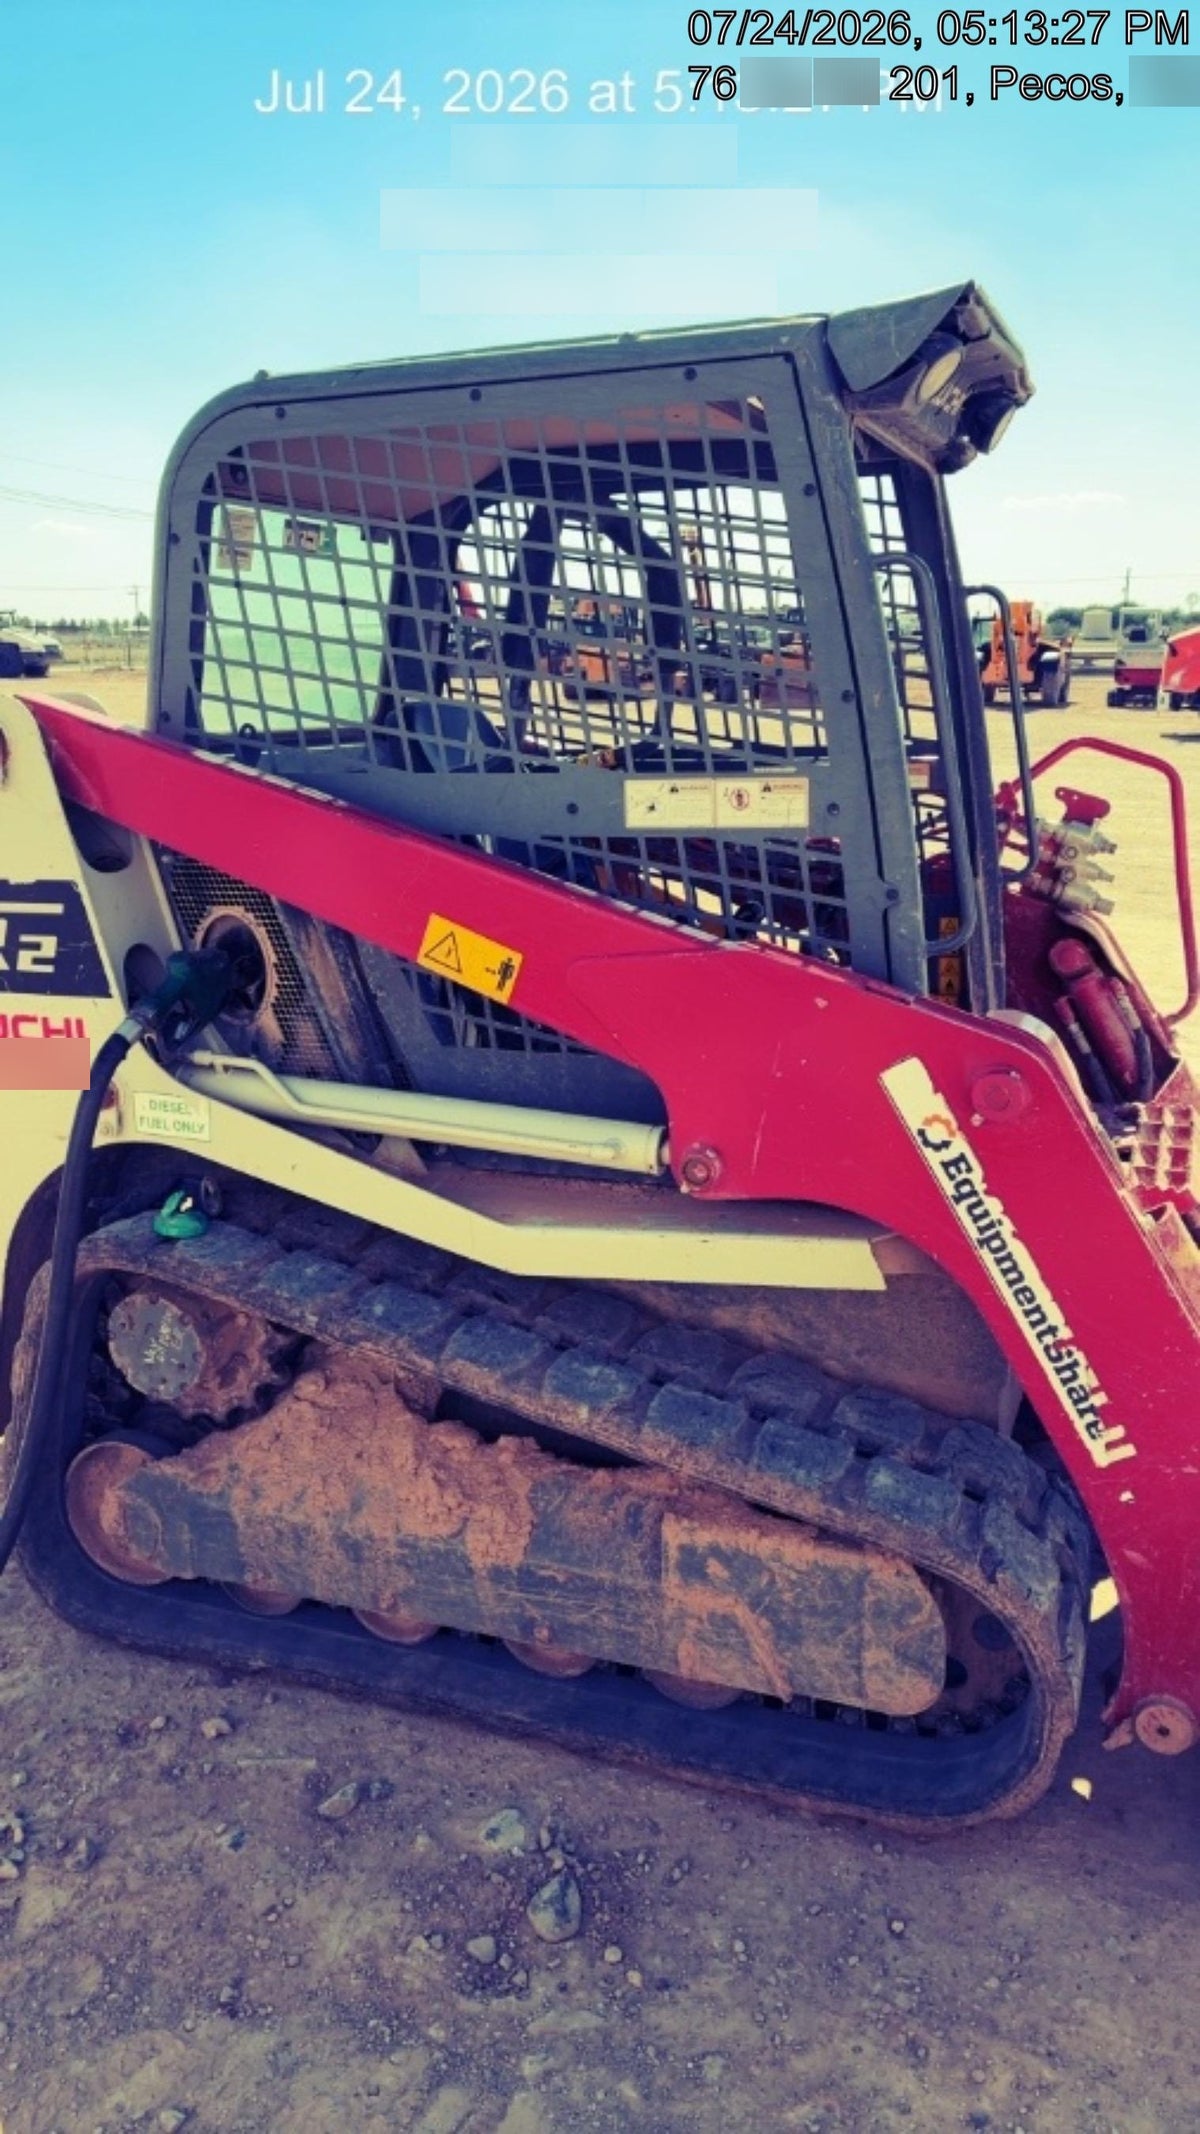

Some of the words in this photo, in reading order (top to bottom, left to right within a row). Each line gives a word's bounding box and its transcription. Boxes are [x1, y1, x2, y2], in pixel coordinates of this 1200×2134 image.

[149, 1099, 192, 1115] DIESEL
[139, 1116, 170, 1131] FUEL
[173, 1119, 205, 1134] ONLY
